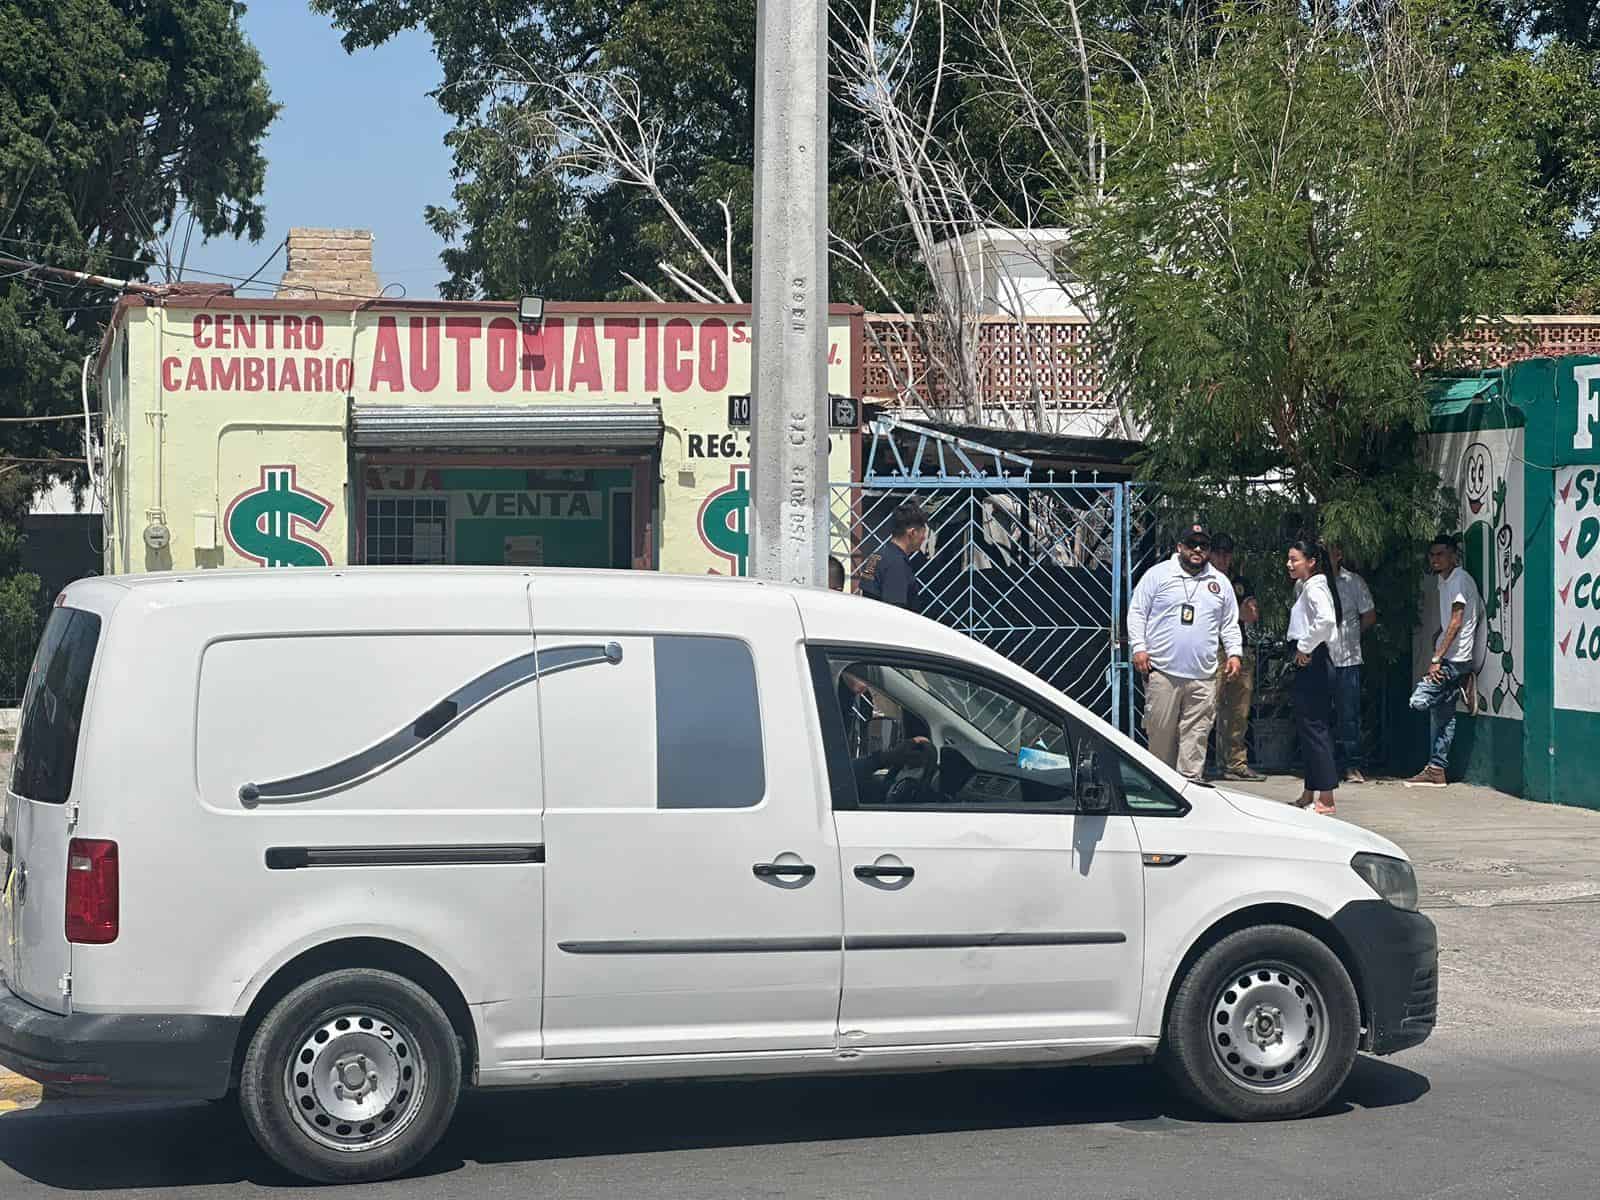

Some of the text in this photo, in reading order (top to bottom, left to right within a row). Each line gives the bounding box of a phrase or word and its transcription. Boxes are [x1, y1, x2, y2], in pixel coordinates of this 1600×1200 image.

[193, 314, 325, 350] CENTRO
[369, 315, 729, 393] AUTOMATICO
[162, 356, 355, 393] CAMBIARIO
[688, 433, 744, 459] REG.
[466, 492, 592, 517] VENTA
